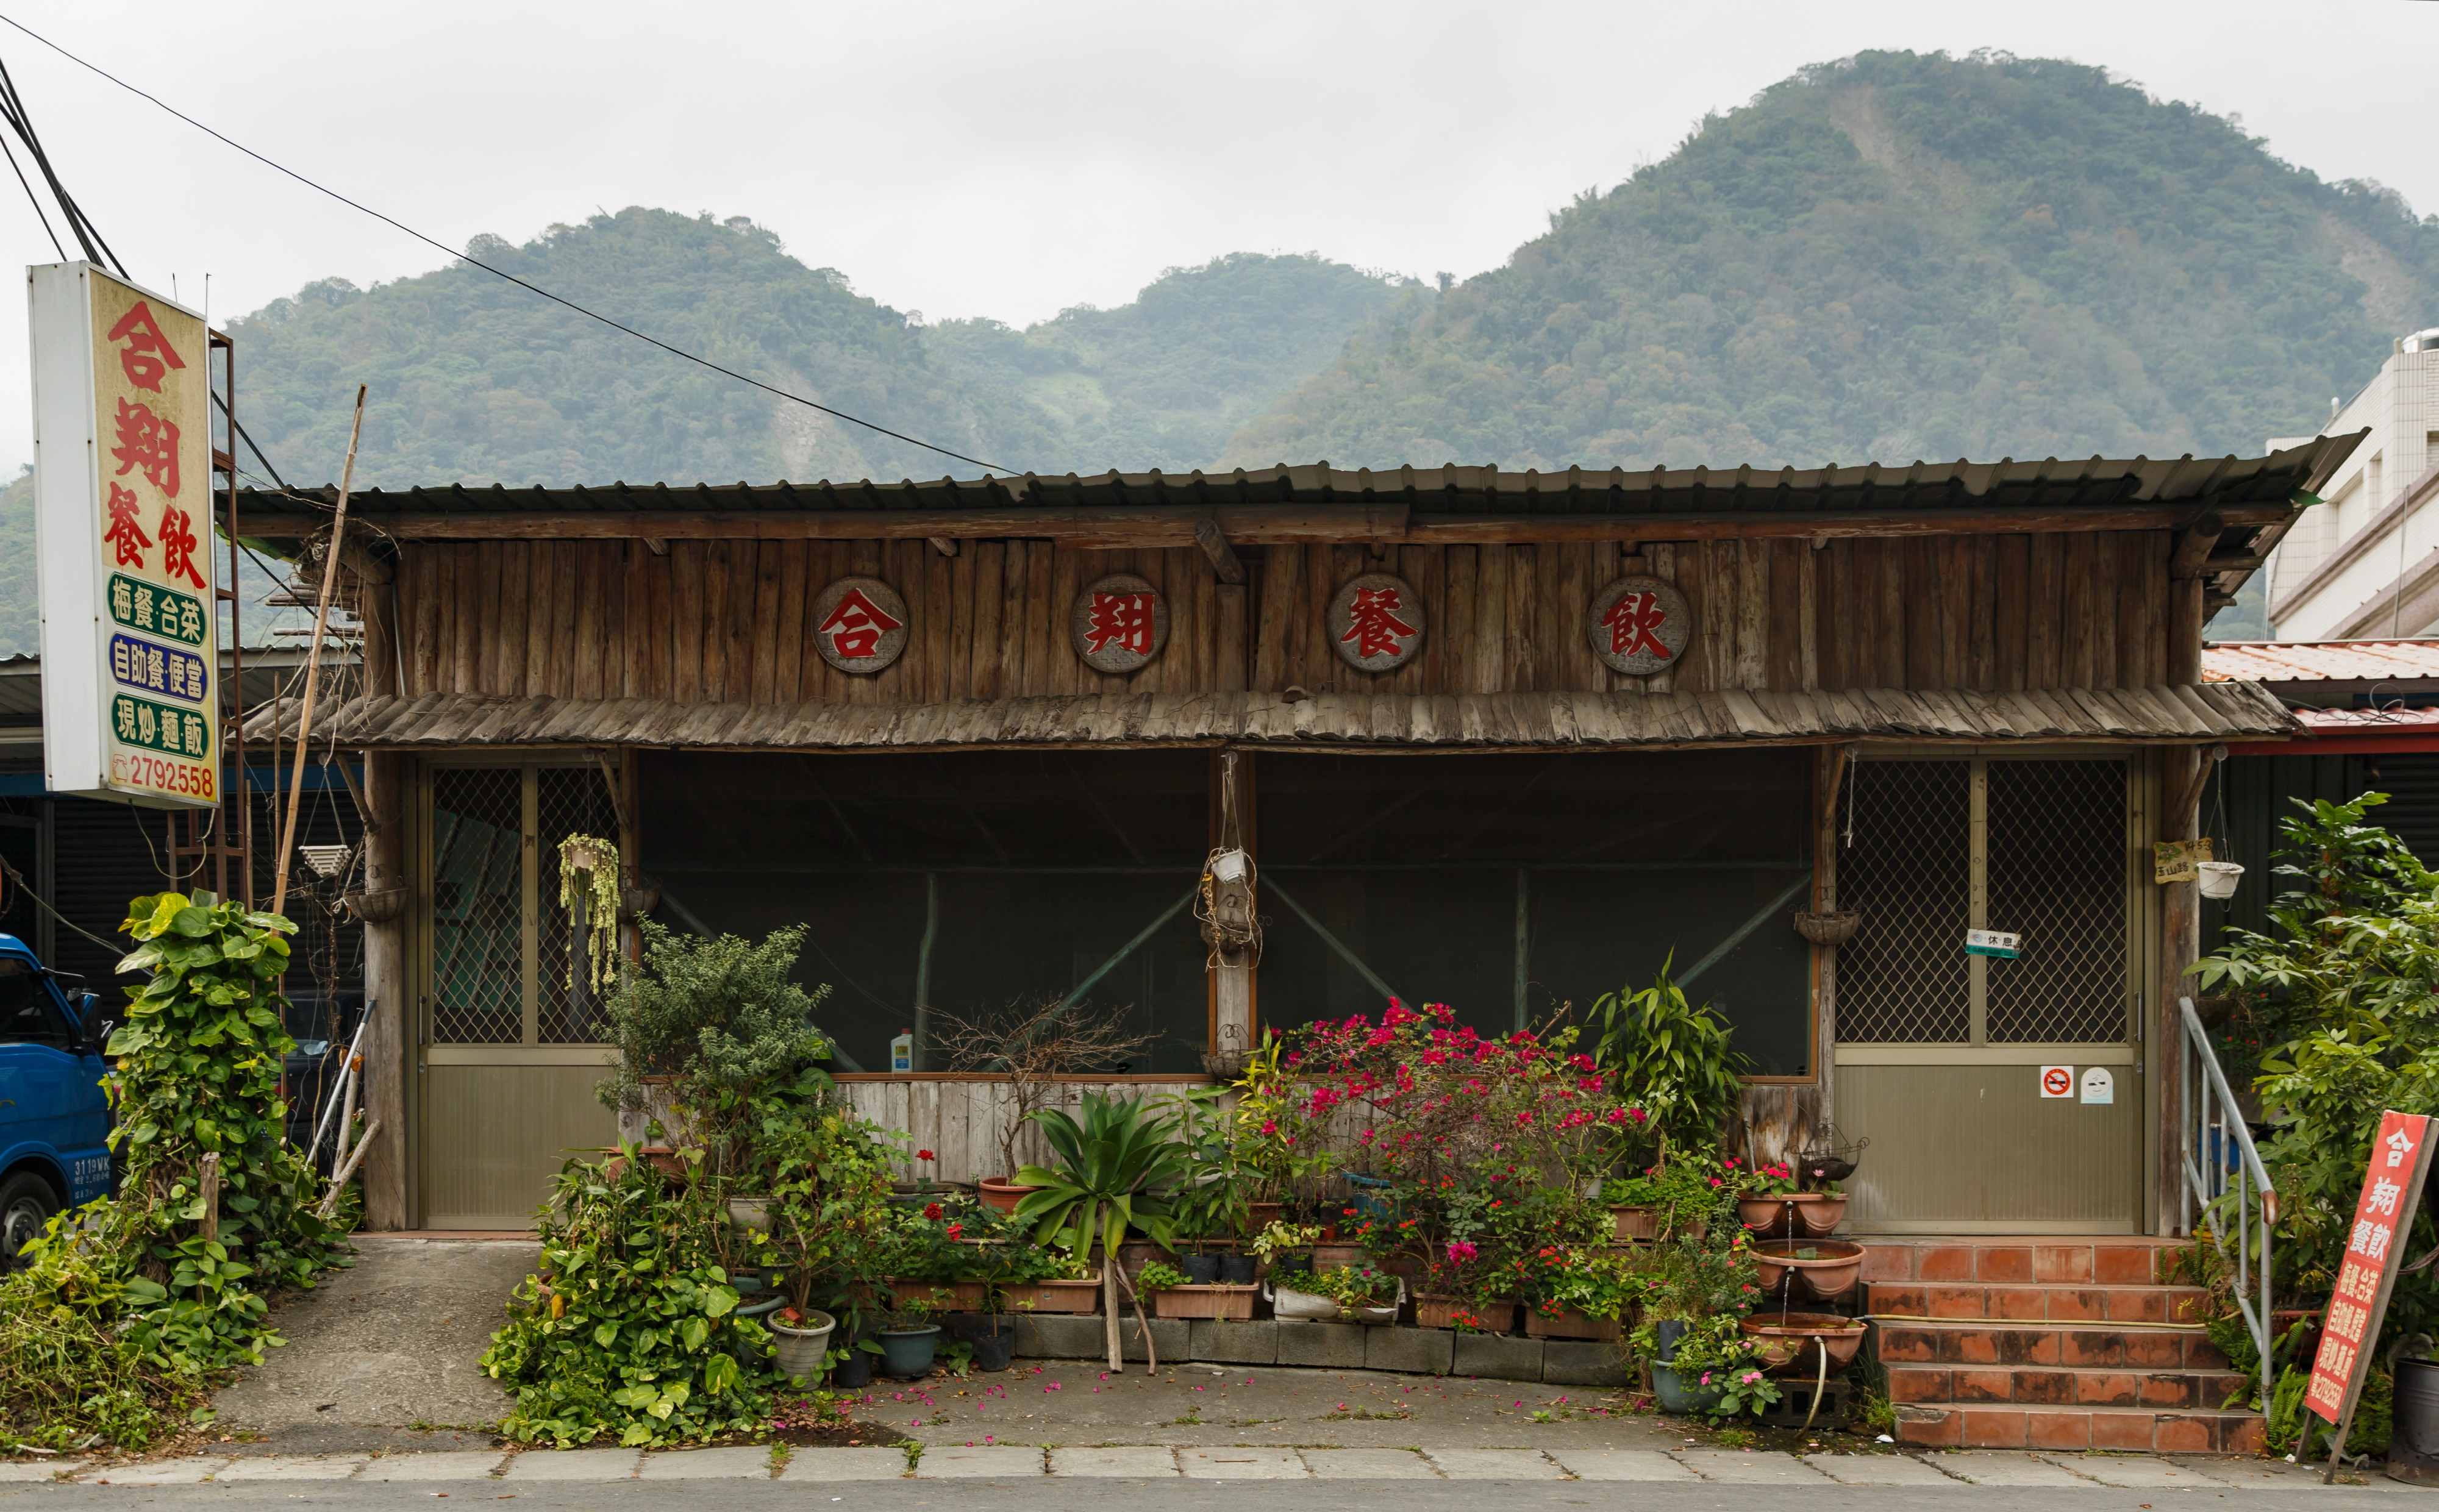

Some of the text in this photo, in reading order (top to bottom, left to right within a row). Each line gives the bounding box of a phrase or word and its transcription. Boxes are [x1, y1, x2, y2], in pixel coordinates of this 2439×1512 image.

[107, 301, 186, 498] 合翔
[104, 481, 207, 589] 餐飲
[818, 587, 1671, 658] 合 翔 餐 飲
[130, 755, 213, 797] 2792558
[1988, 935, 2013, 947] 休息
[75, 1156, 110, 1176] 3119WK
[2349, 1218, 2390, 1261] 餐飲
